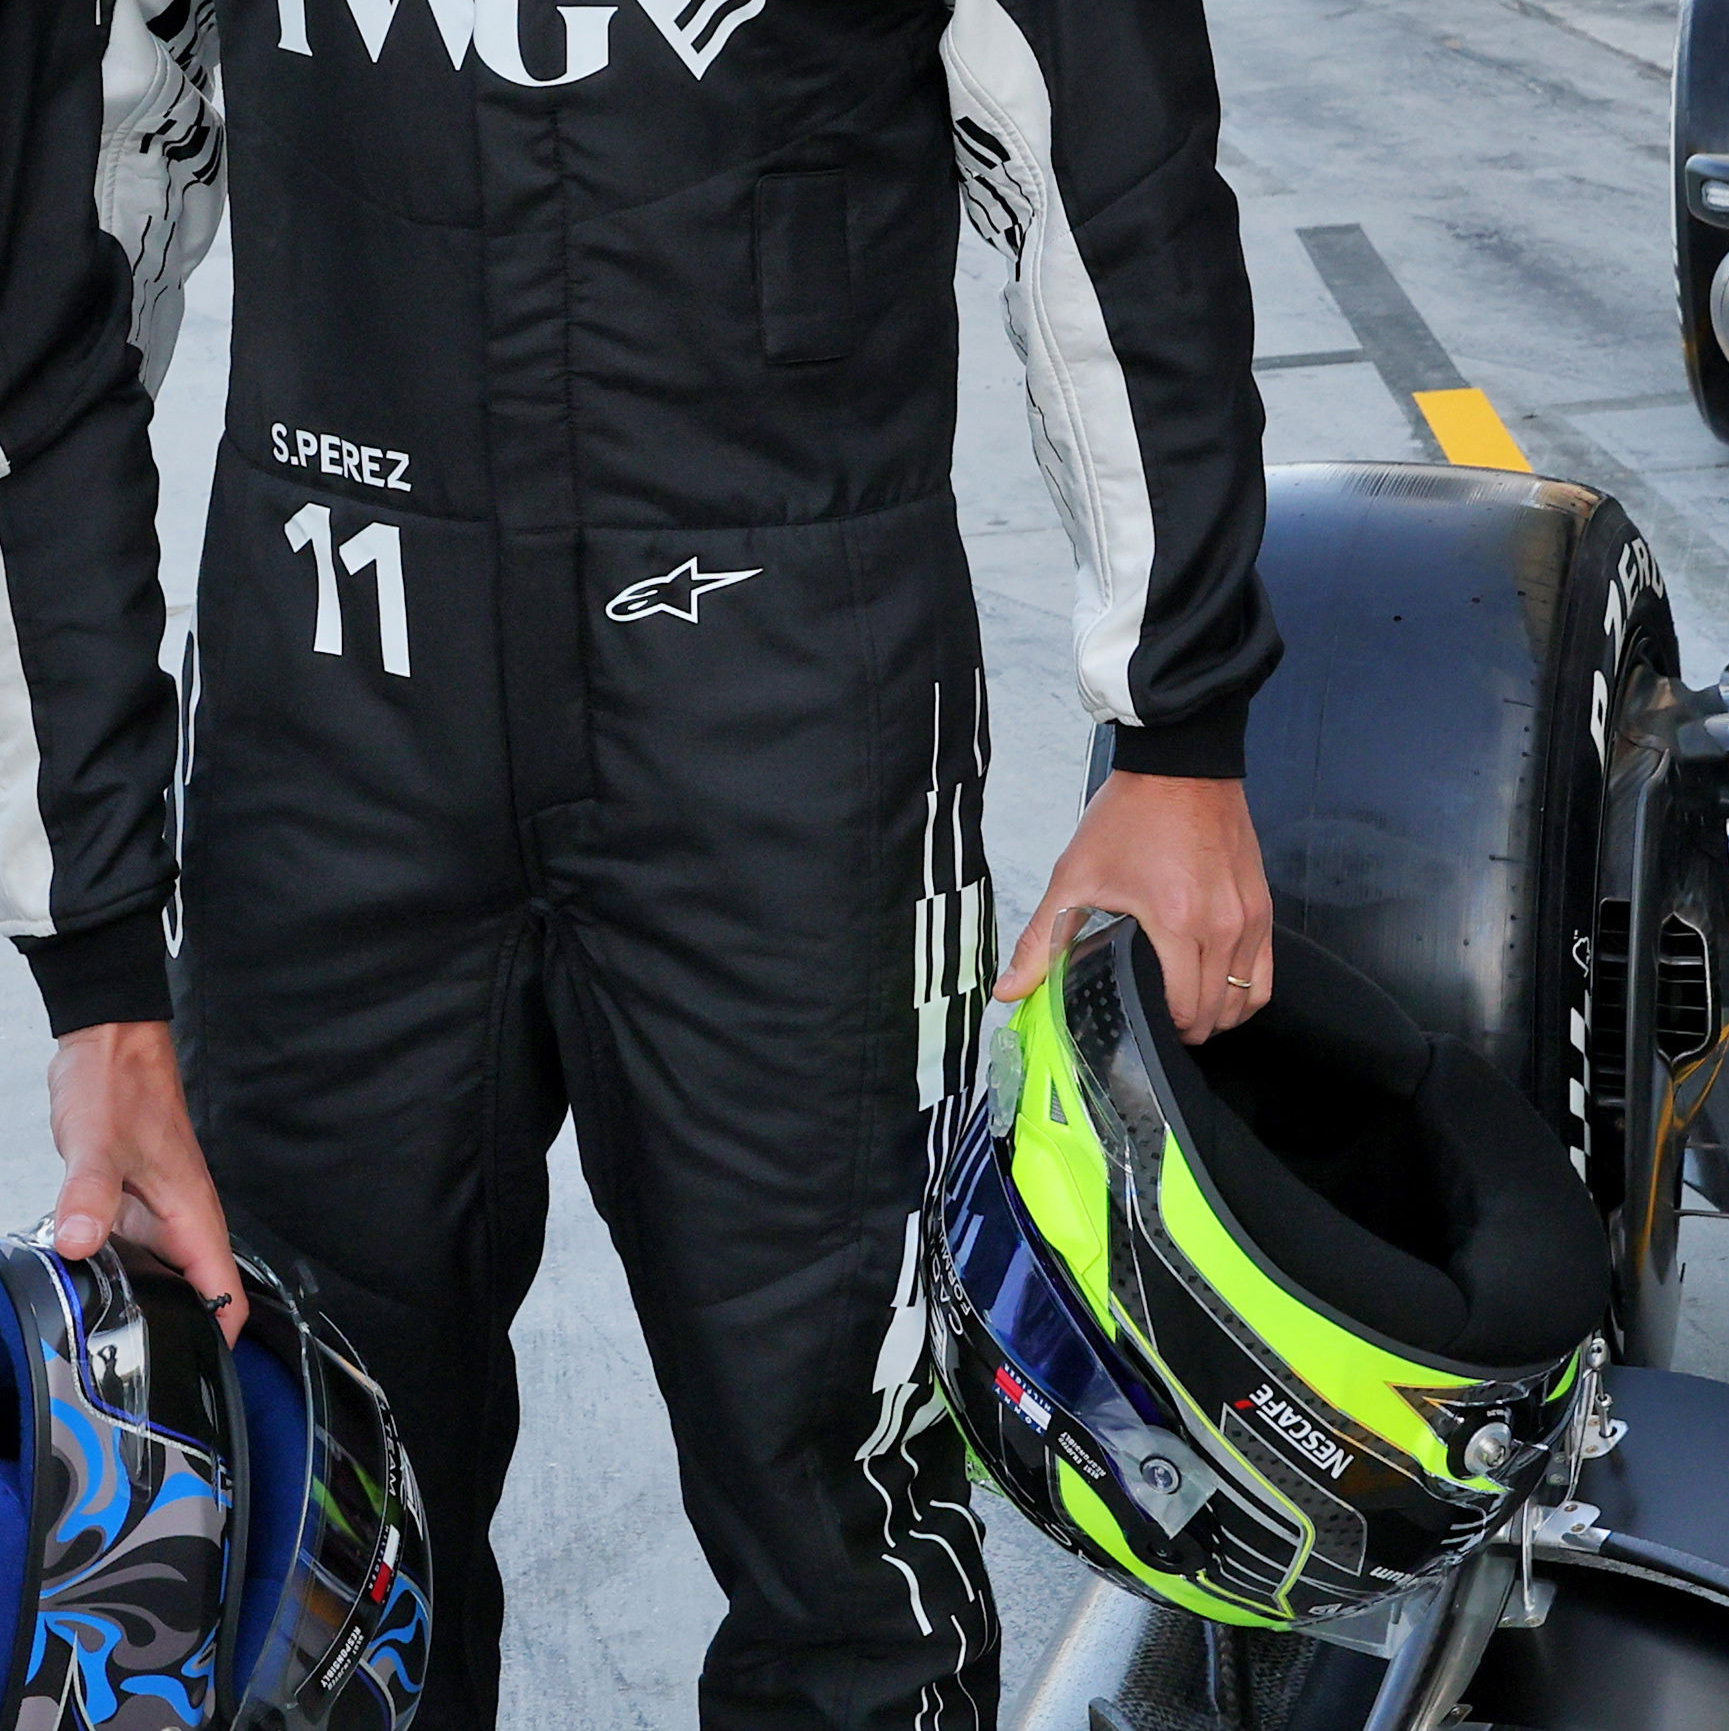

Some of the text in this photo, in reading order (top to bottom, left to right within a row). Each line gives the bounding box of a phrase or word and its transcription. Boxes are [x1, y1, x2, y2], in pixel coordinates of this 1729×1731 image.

[271, 422, 412, 492] S.PEREZ
[284, 502, 411, 678] 11
[993, 1385, 1044, 1435] TOMMY
[320, 1625, 362, 1689] RESPONSIBLY
